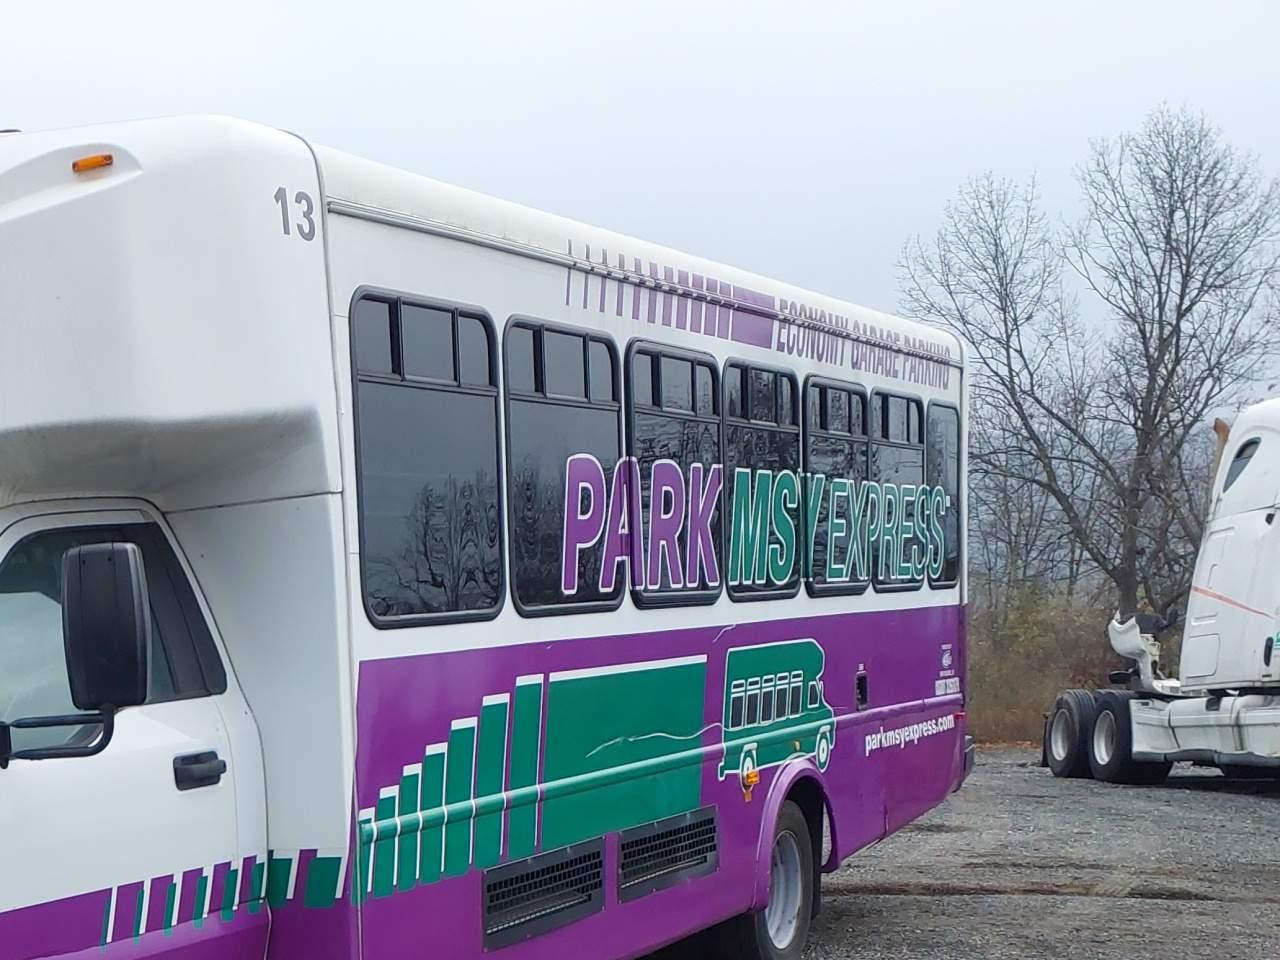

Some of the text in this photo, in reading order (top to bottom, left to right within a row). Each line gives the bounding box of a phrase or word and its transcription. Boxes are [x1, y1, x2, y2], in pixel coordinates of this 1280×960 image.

[274, 186, 316, 242] 13
[776, 298, 952, 390] ECONOMY GARAGE PARKING
[561, 453, 723, 595] PARK
[728, 467, 825, 586] MSY
[865, 714, 955, 757] parkmsyexpress.com
